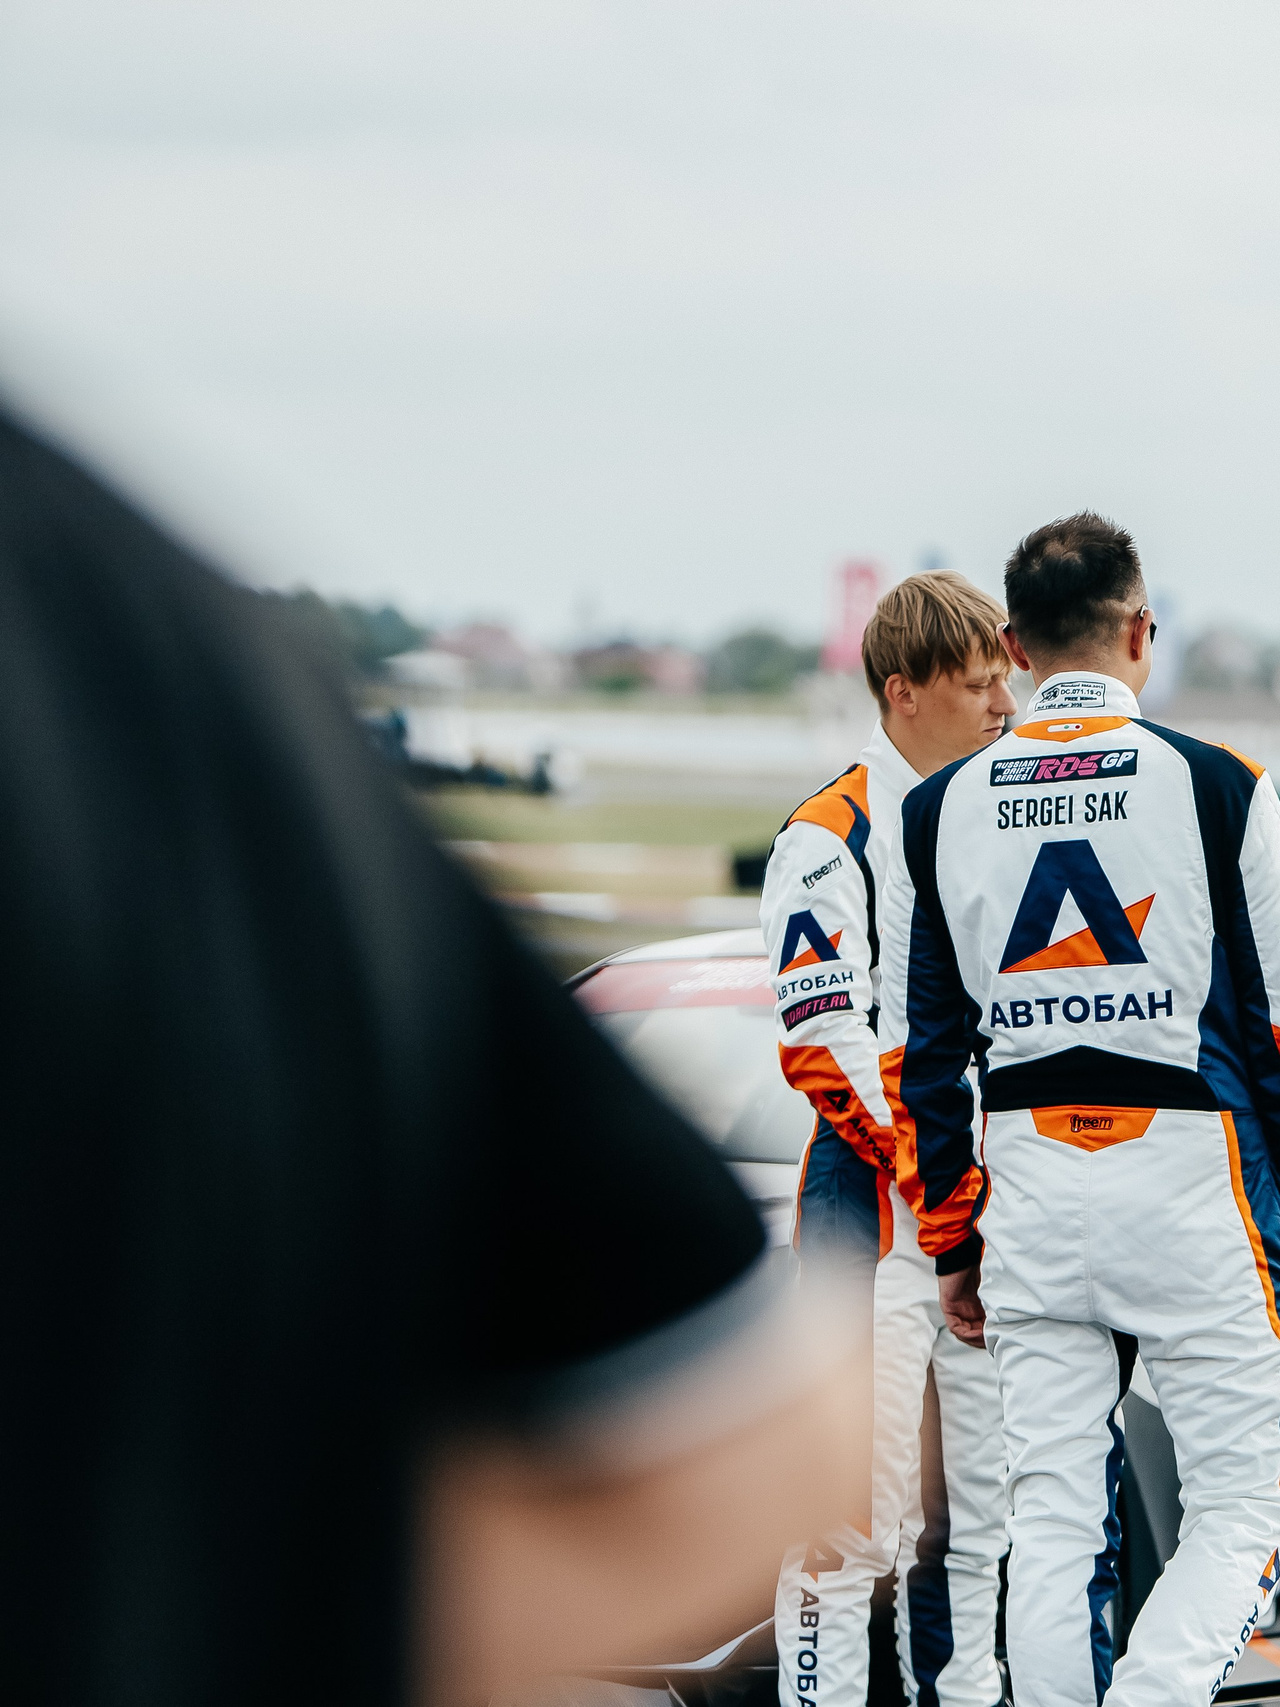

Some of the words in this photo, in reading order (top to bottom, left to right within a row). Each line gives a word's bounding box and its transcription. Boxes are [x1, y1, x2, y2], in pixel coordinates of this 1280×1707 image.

[994, 760, 1034, 770] RUSSIAN
[1101, 751, 1136, 769] GP
[994, 774, 1029, 783] SERIES
[997, 795, 1074, 830] SERGEI
[1084, 790, 1129, 823] SAK
[802, 854, 843, 890] freem
[990, 988, 1174, 1029] АВТОБАН
[1070, 1114, 1113, 1132] freem
[846, 1117, 893, 1170] АВТОБ
[797, 1586, 820, 1707] АВТОБА
